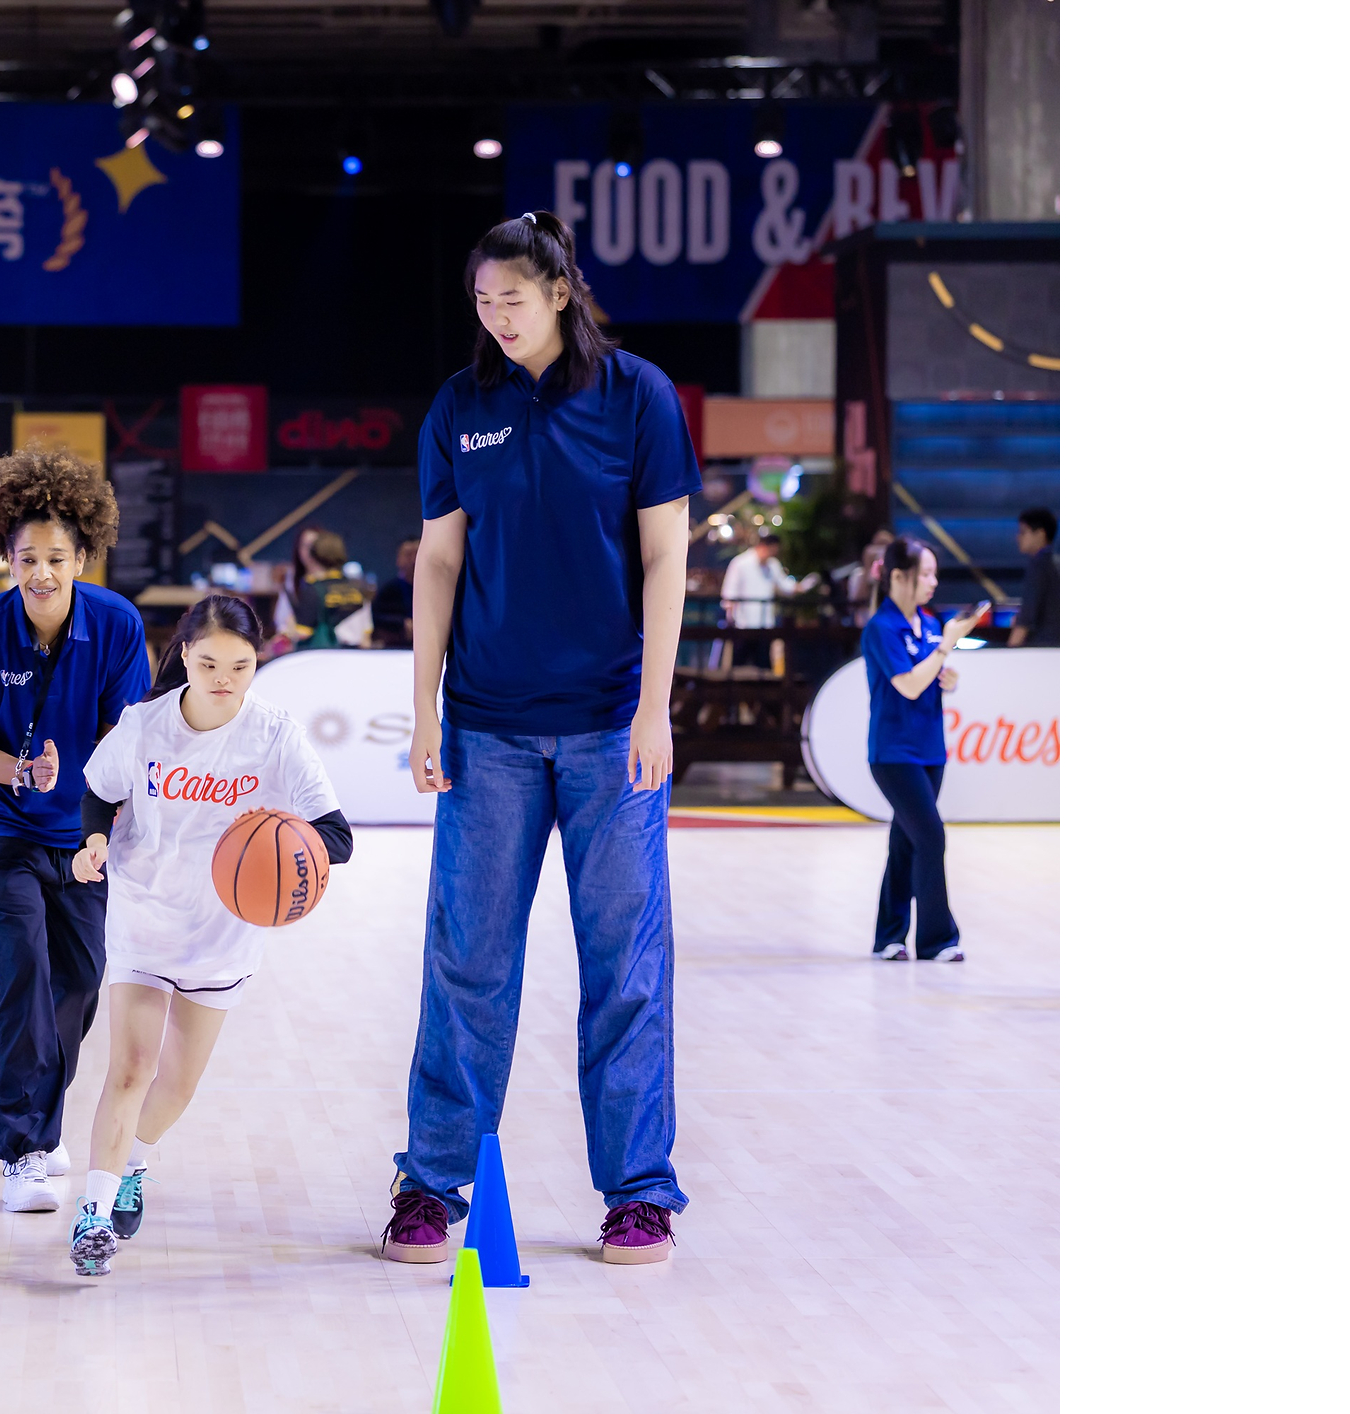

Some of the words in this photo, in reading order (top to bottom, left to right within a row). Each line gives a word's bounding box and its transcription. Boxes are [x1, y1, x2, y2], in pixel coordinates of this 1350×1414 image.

[554, 157, 732, 267] FOOD
[753, 157, 815, 267] &
[470, 431, 505, 451] Cares
[162, 766, 240, 807] Cares
[284, 848, 309, 923] Wilson
